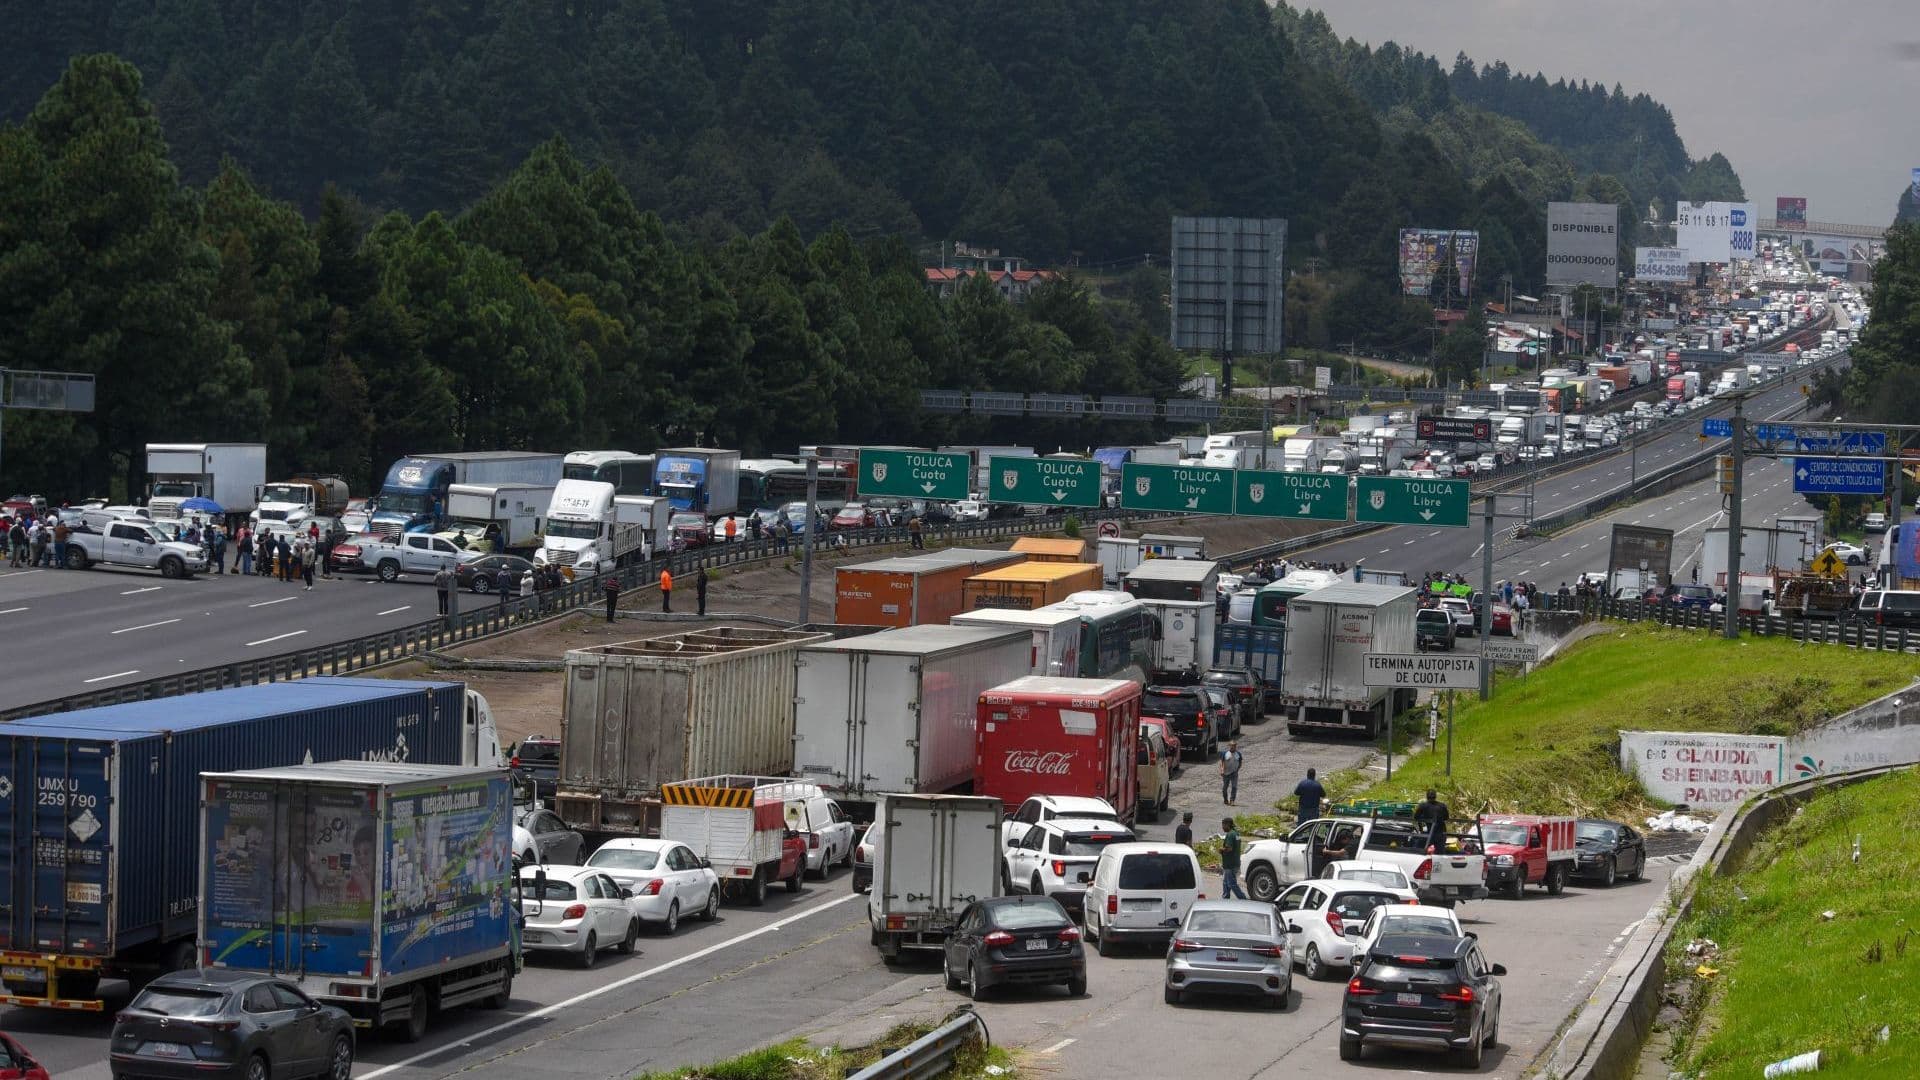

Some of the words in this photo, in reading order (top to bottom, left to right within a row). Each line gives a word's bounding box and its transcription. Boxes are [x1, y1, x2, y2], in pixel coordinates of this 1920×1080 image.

[1679, 214, 1689, 226] 56
[1693, 215, 1701, 226] 11
[1720, 215, 1729, 227] 17
[1552, 223, 1615, 234] DISPONIBLE
[906, 455, 952, 468] TOLUCA
[1810, 462, 1829, 472] CENTRO
[875, 469, 885, 479] 15
[912, 468, 945, 480] Cuota
[1036, 462, 1084, 475] TOLUCA
[1043, 476, 1077, 488] Cuota
[1173, 469, 1221, 483] TOLUCA
[1283, 476, 1331, 489] TOLUCA
[1809, 475, 1844, 485] EXPOSICIONES
[1846, 475, 1865, 485] TOLUCA
[1138, 482, 1147, 492] 15
[1179, 482, 1207, 495] Libre
[1252, 489, 1262, 499] 15
[1294, 489, 1321, 501] Libre
[1404, 482, 1453, 495] TOLUCA
[1413, 495, 1441, 507] Libre
[1368, 657, 1414, 670] TERMINA
[1417, 658, 1475, 671] AUTOPISTA
[1395, 671, 1409, 683] DE
[1413, 672, 1446, 684] CUOTA
[1675, 748, 1759, 765] CLAUDIA
[1661, 767, 1773, 785] SHEINBAUM
[38, 792, 65, 806] 259
[70, 793, 97, 808] 790
